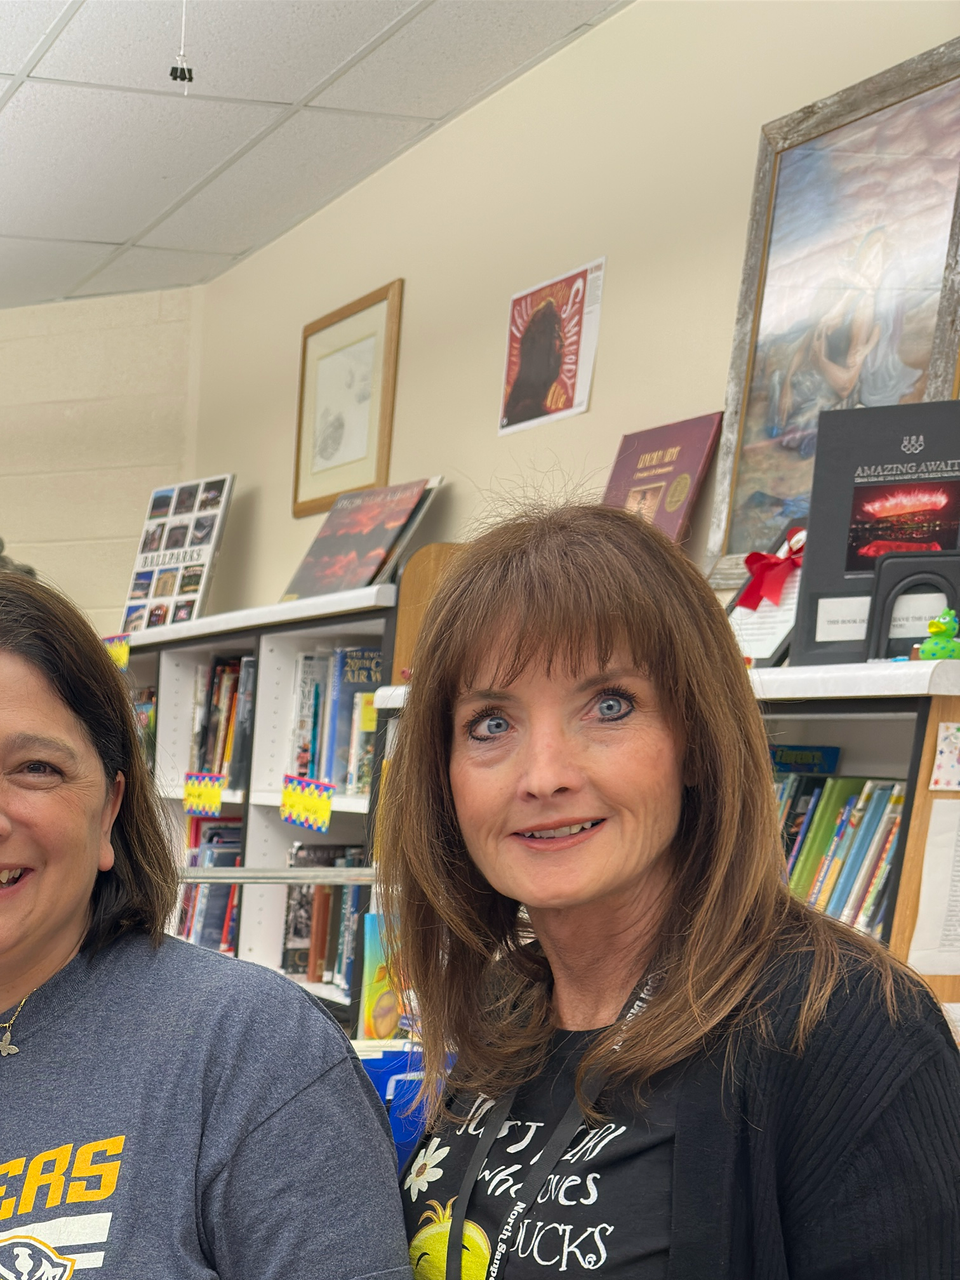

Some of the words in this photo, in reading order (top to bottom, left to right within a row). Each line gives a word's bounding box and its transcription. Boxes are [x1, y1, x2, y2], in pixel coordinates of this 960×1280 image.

[854, 463, 917, 477] AMAZING
[141, 548, 204, 568] BALLPARKS
[343, 670, 369, 682] AIR
[498, 1201, 527, 1244] North
